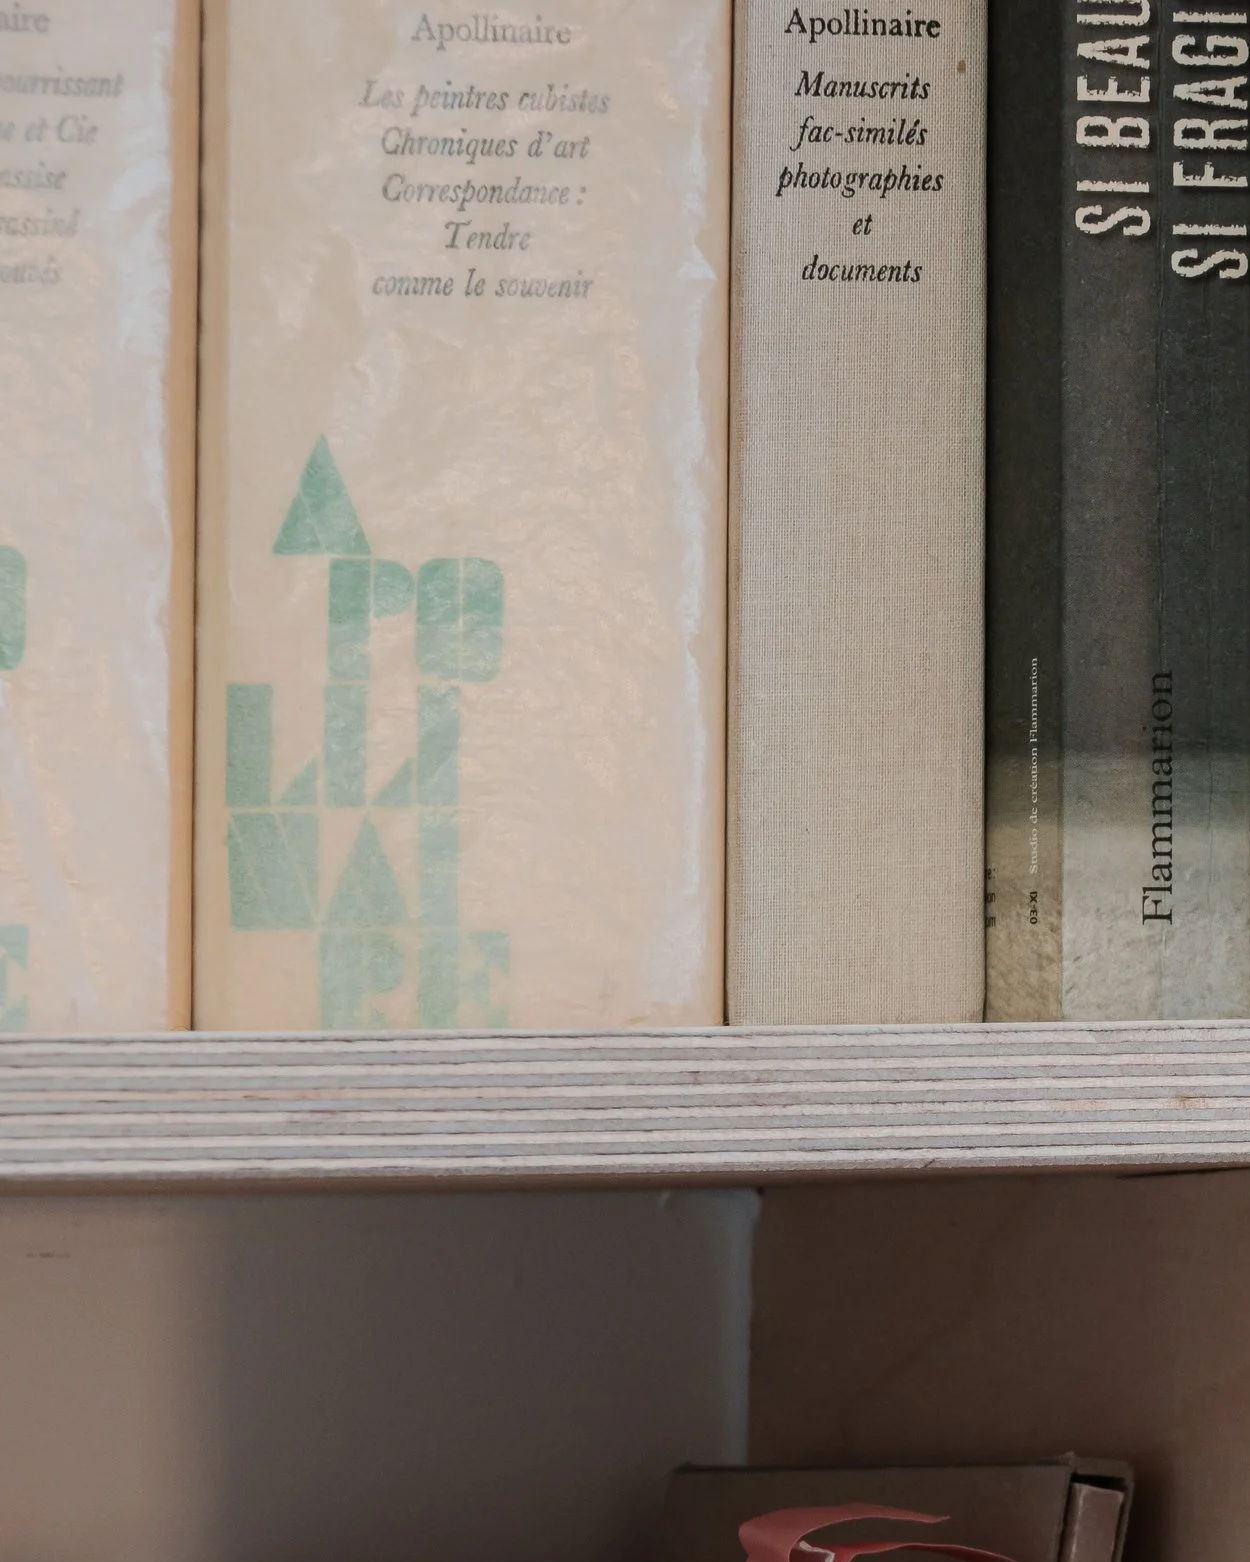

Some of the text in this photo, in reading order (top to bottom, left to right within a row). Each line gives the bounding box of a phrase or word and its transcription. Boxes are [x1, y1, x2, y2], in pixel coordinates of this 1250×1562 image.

[411, 14, 572, 50] Apollinaire
[784, 6, 941, 42] Apollinaire
[359, 80, 611, 115] Les peintres cubistes
[794, 71, 930, 100] Manuscrits
[381, 126, 590, 165] Chroniques d'art
[790, 115, 927, 151] fac-similés
[776, 163, 944, 198] photographies
[852, 213, 873, 237] et
[1075, 179, 1151, 237] SI
[444, 222, 531, 252] Tendre
[1170, 224, 1249, 280] SI
[372, 269, 593, 300] comme le souvenir
[802, 255, 922, 284] documents
[1029, 657, 1038, 743] Flammarion
[1029, 747, 1038, 803] création
[1029, 806, 1038, 825] de
[1142, 670, 1173, 925] Flammarion
